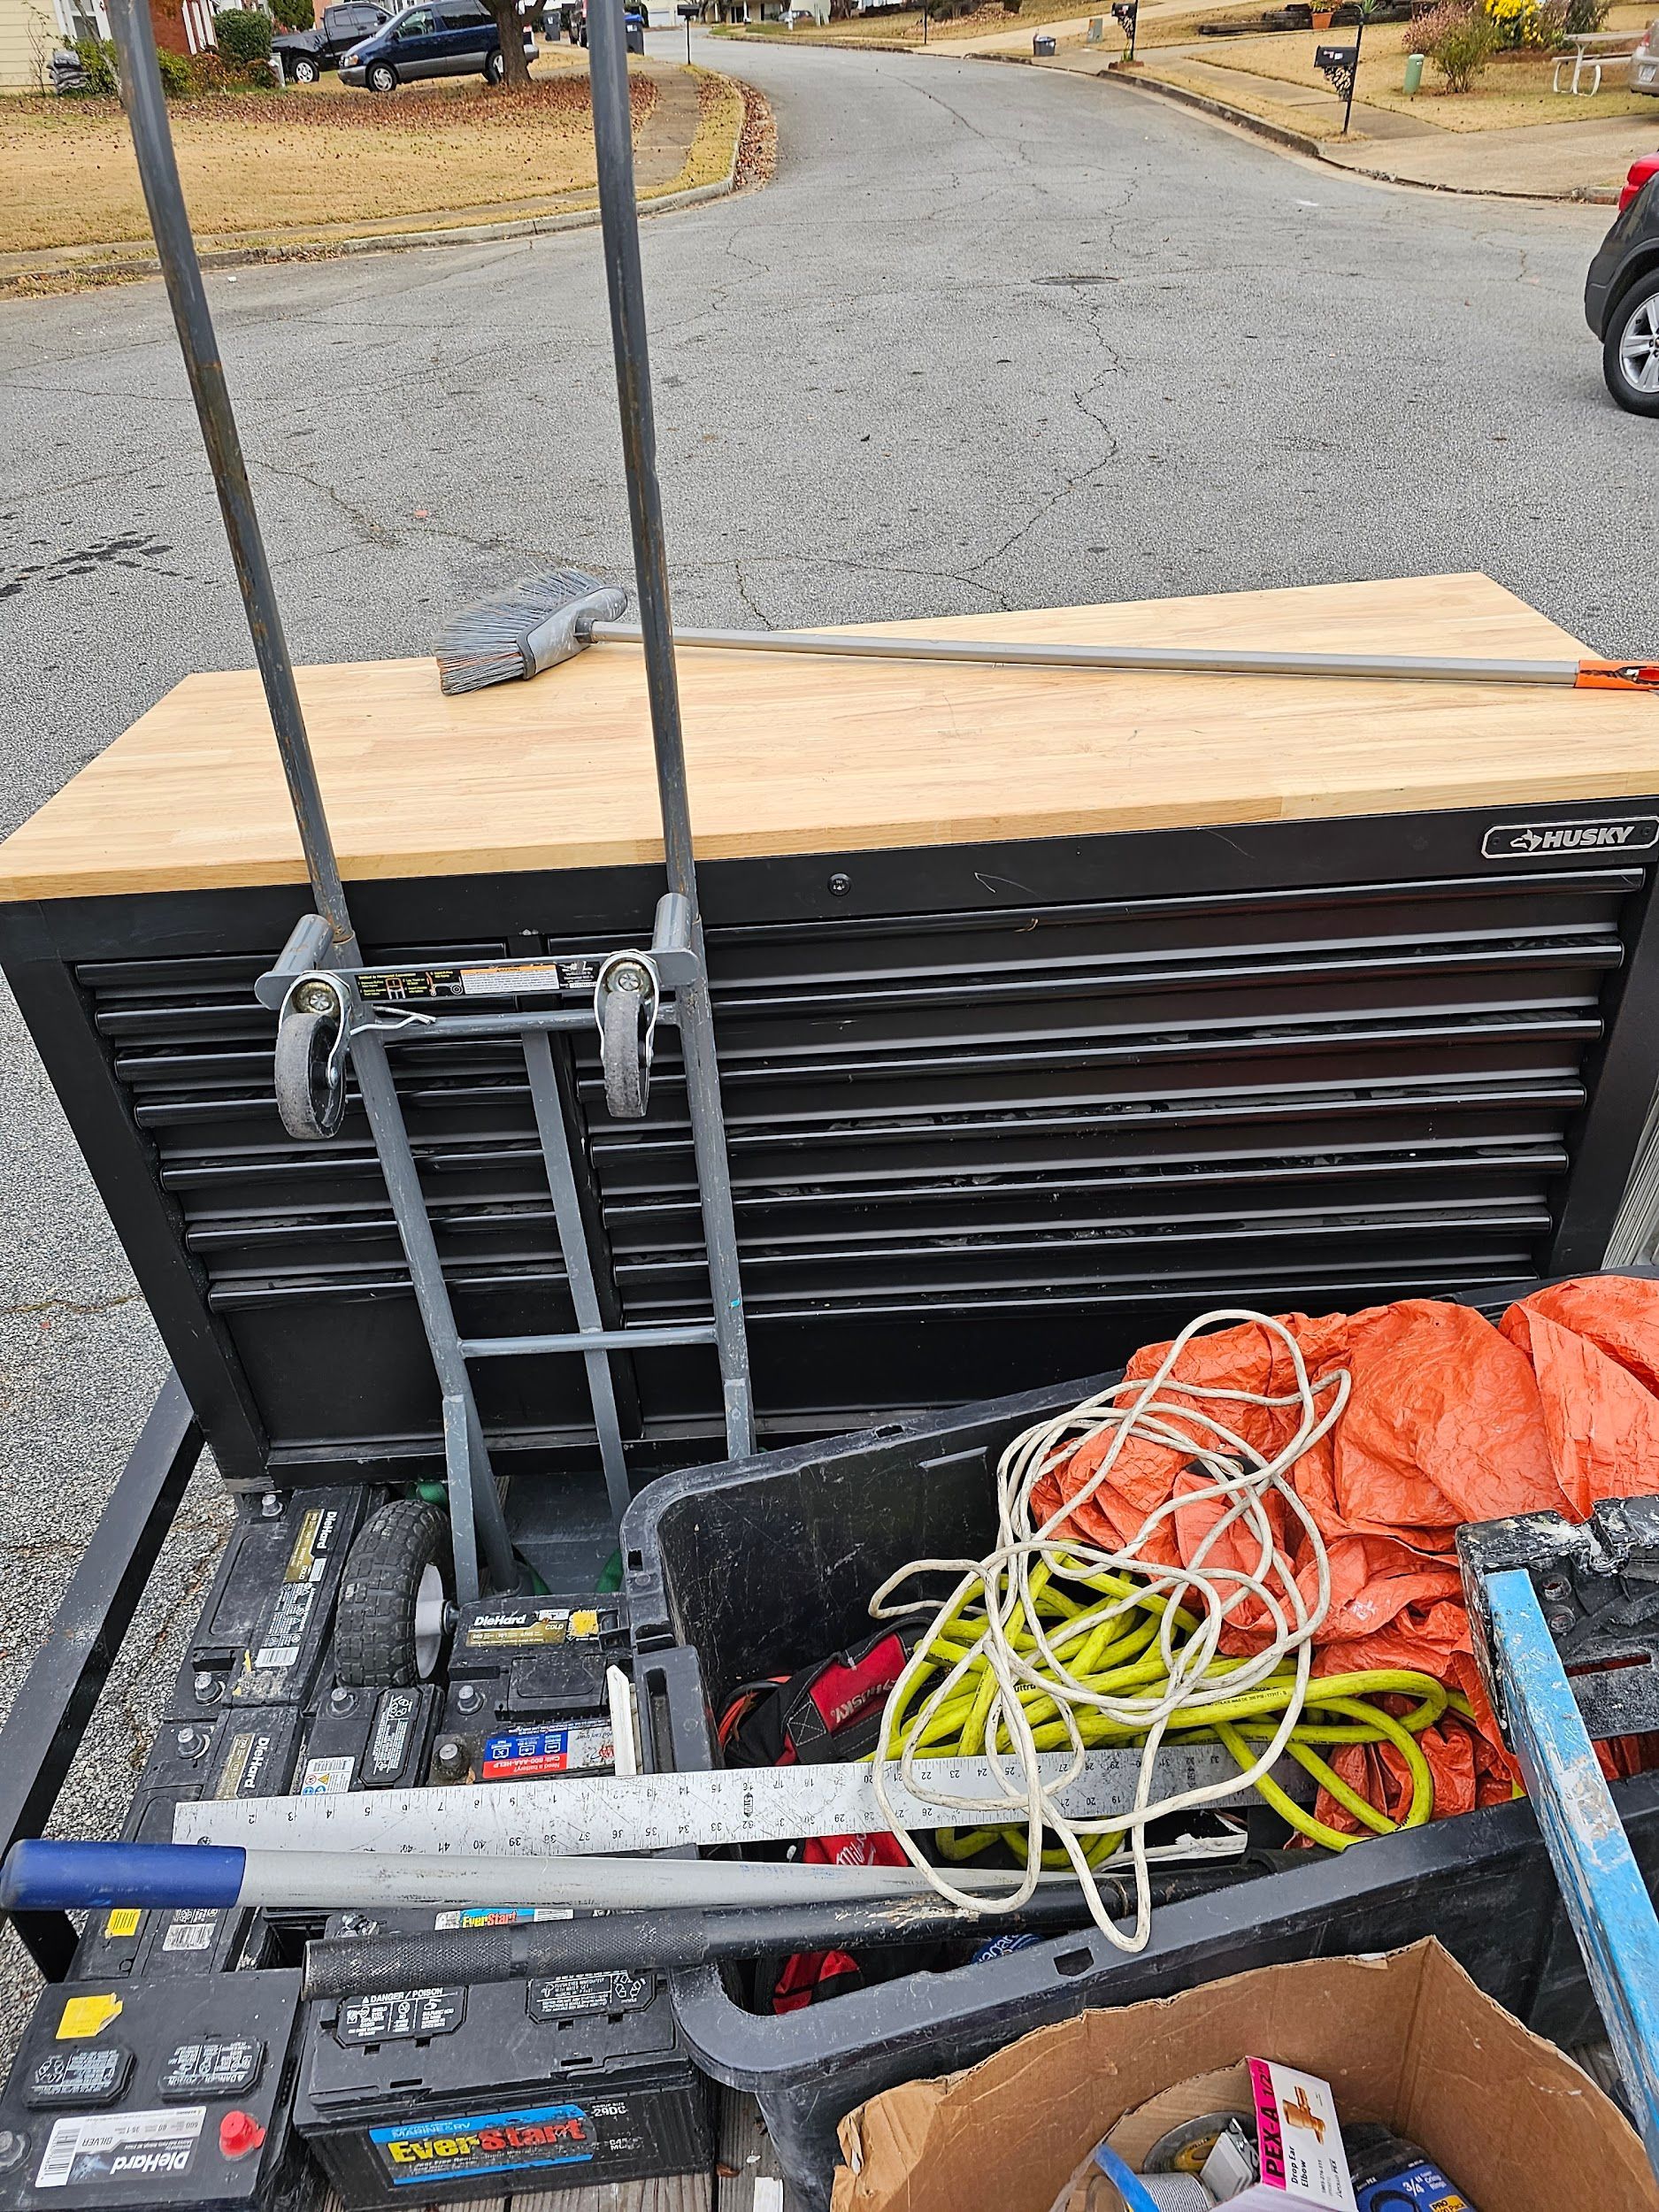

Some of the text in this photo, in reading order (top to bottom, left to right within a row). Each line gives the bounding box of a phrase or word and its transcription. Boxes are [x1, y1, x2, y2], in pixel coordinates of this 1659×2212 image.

[1542, 826, 1634, 848] HUSKY
[317, 1511, 338, 1549] DieHard
[473, 1614, 527, 1626] DieHard
[833, 1684, 882, 1724] HUSKY
[244, 1737, 271, 1788] DieHard
[493, 1757, 543, 1768] 800-AAA-HELP
[1210, 1755, 1219, 1764] 33
[1058, 1763, 1068, 1773] 27
[1110, 1761, 1119, 1770] 29
[921, 1770, 931, 1780] 22
[949, 1770, 959, 1778] 23
[977, 1768, 987, 1777] 24
[1004, 1766, 1015, 1776] 25
[711, 1784, 721, 1793] 15
[742, 1782, 753, 1791] 16
[772, 1780, 783, 1789] 17
[680, 1786, 689, 1796] 14
[473, 1800, 479, 1809] 8
[509, 1797, 515, 1807] 9
[744, 1795, 753, 1814] STUD
[1060, 1800, 1070, 1809] 21
[1087, 1797, 1095, 1806] 20
[1112, 1795, 1121, 1804] 19
[402, 1804, 408, 1814] 6
[437, 1801, 443, 1811] 7
[288, 1812, 294, 1821] 3
[326, 1809, 332, 1818] 4
[365, 1807, 371, 1816] 5
[864, 1811, 874, 1821] 28
[922, 1807, 933, 1816] 26
[248, 1814, 256, 1824] 2
[833, 1813, 845, 1823] 29
[678, 1824, 689, 1834] 34
[710, 1822, 722, 1832] 33
[742, 1820, 753, 1829] 32
[579, 1832, 590, 1841] 37
[612, 1830, 623, 1839] 36
[645, 1827, 657, 1837] 35
[509, 1837, 521, 1847] 39
[462, 1911, 518, 1928] EverStart
[371, 1991, 405, 2002] DANGER
[412, 1987, 443, 1998] POISON
[594, 2106, 626, 2117] 29DC
[1258, 2066, 1284, 2177] PEX-A 1/2"
[392, 2125, 443, 2139] MARINE
[453, 2122, 471, 2131] RV
[81, 2137, 113, 2147] SILVER
[388, 2118, 585, 2162] EverStart
[109, 2150, 190, 2175] DieHard
[1300, 2160, 1309, 2187] Elbow
[1402, 2176, 1425, 2197] 3/4"
[1432, 2200, 1448, 2210] PRO
